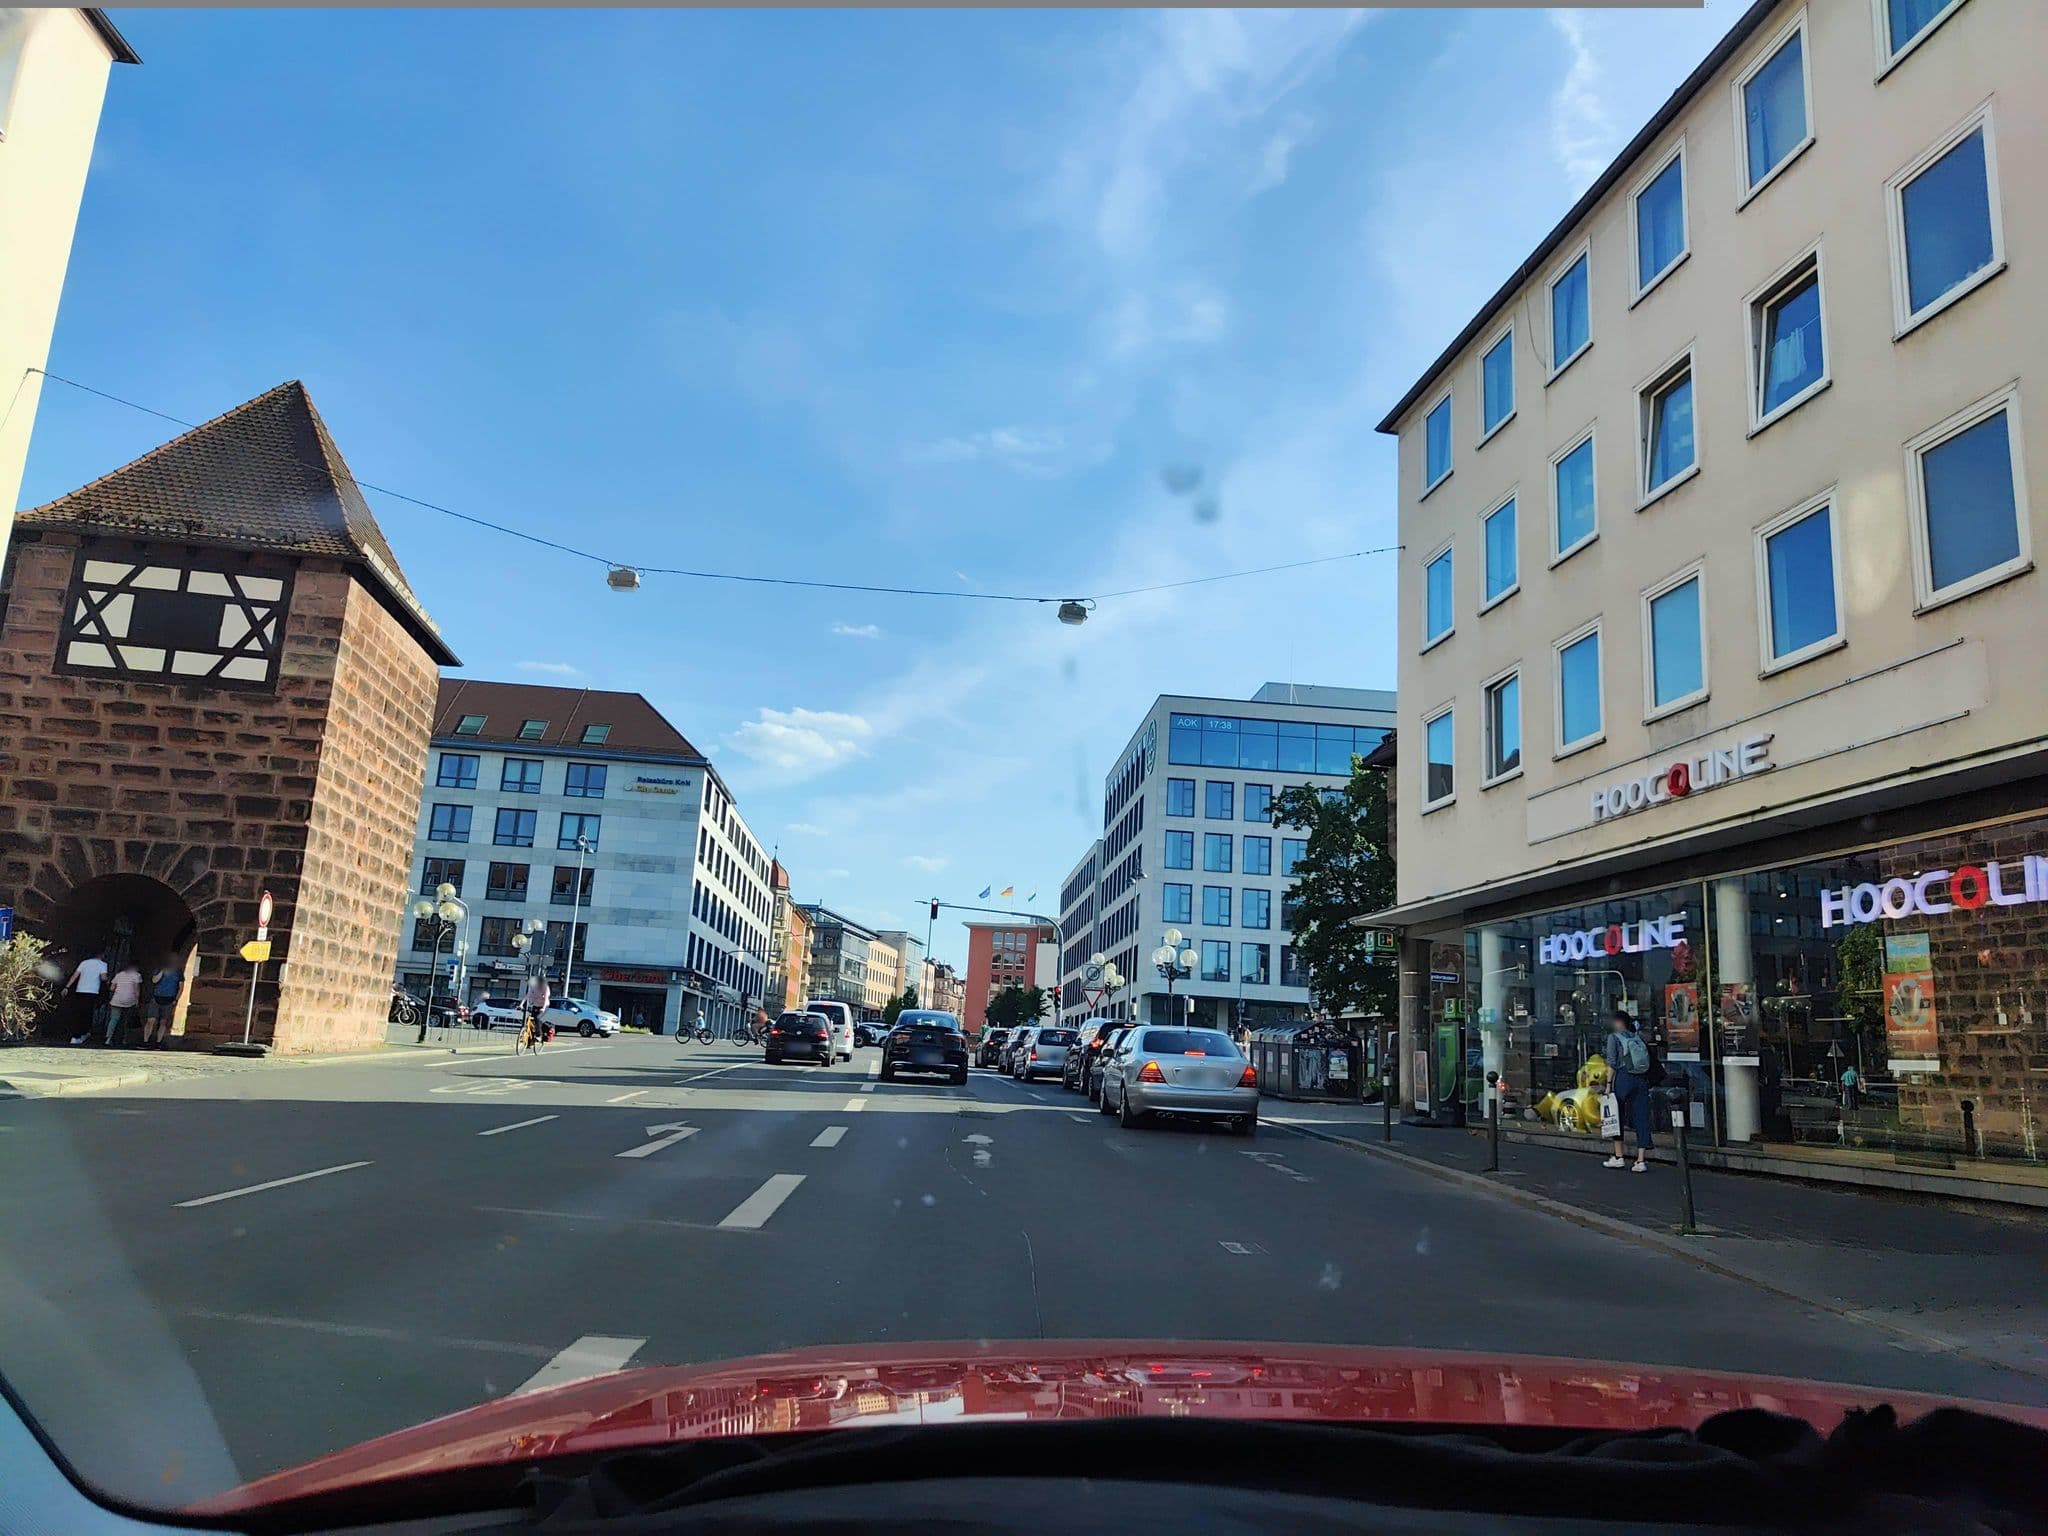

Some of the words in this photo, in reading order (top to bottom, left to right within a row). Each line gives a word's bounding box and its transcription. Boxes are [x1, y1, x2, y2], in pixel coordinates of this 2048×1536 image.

[1177, 718, 1199, 728] AOK
[1209, 720, 1233, 730] 17:38
[1589, 733, 1774, 821] HOOCOLINE
[1539, 911, 1688, 965] HOOCOLINE
